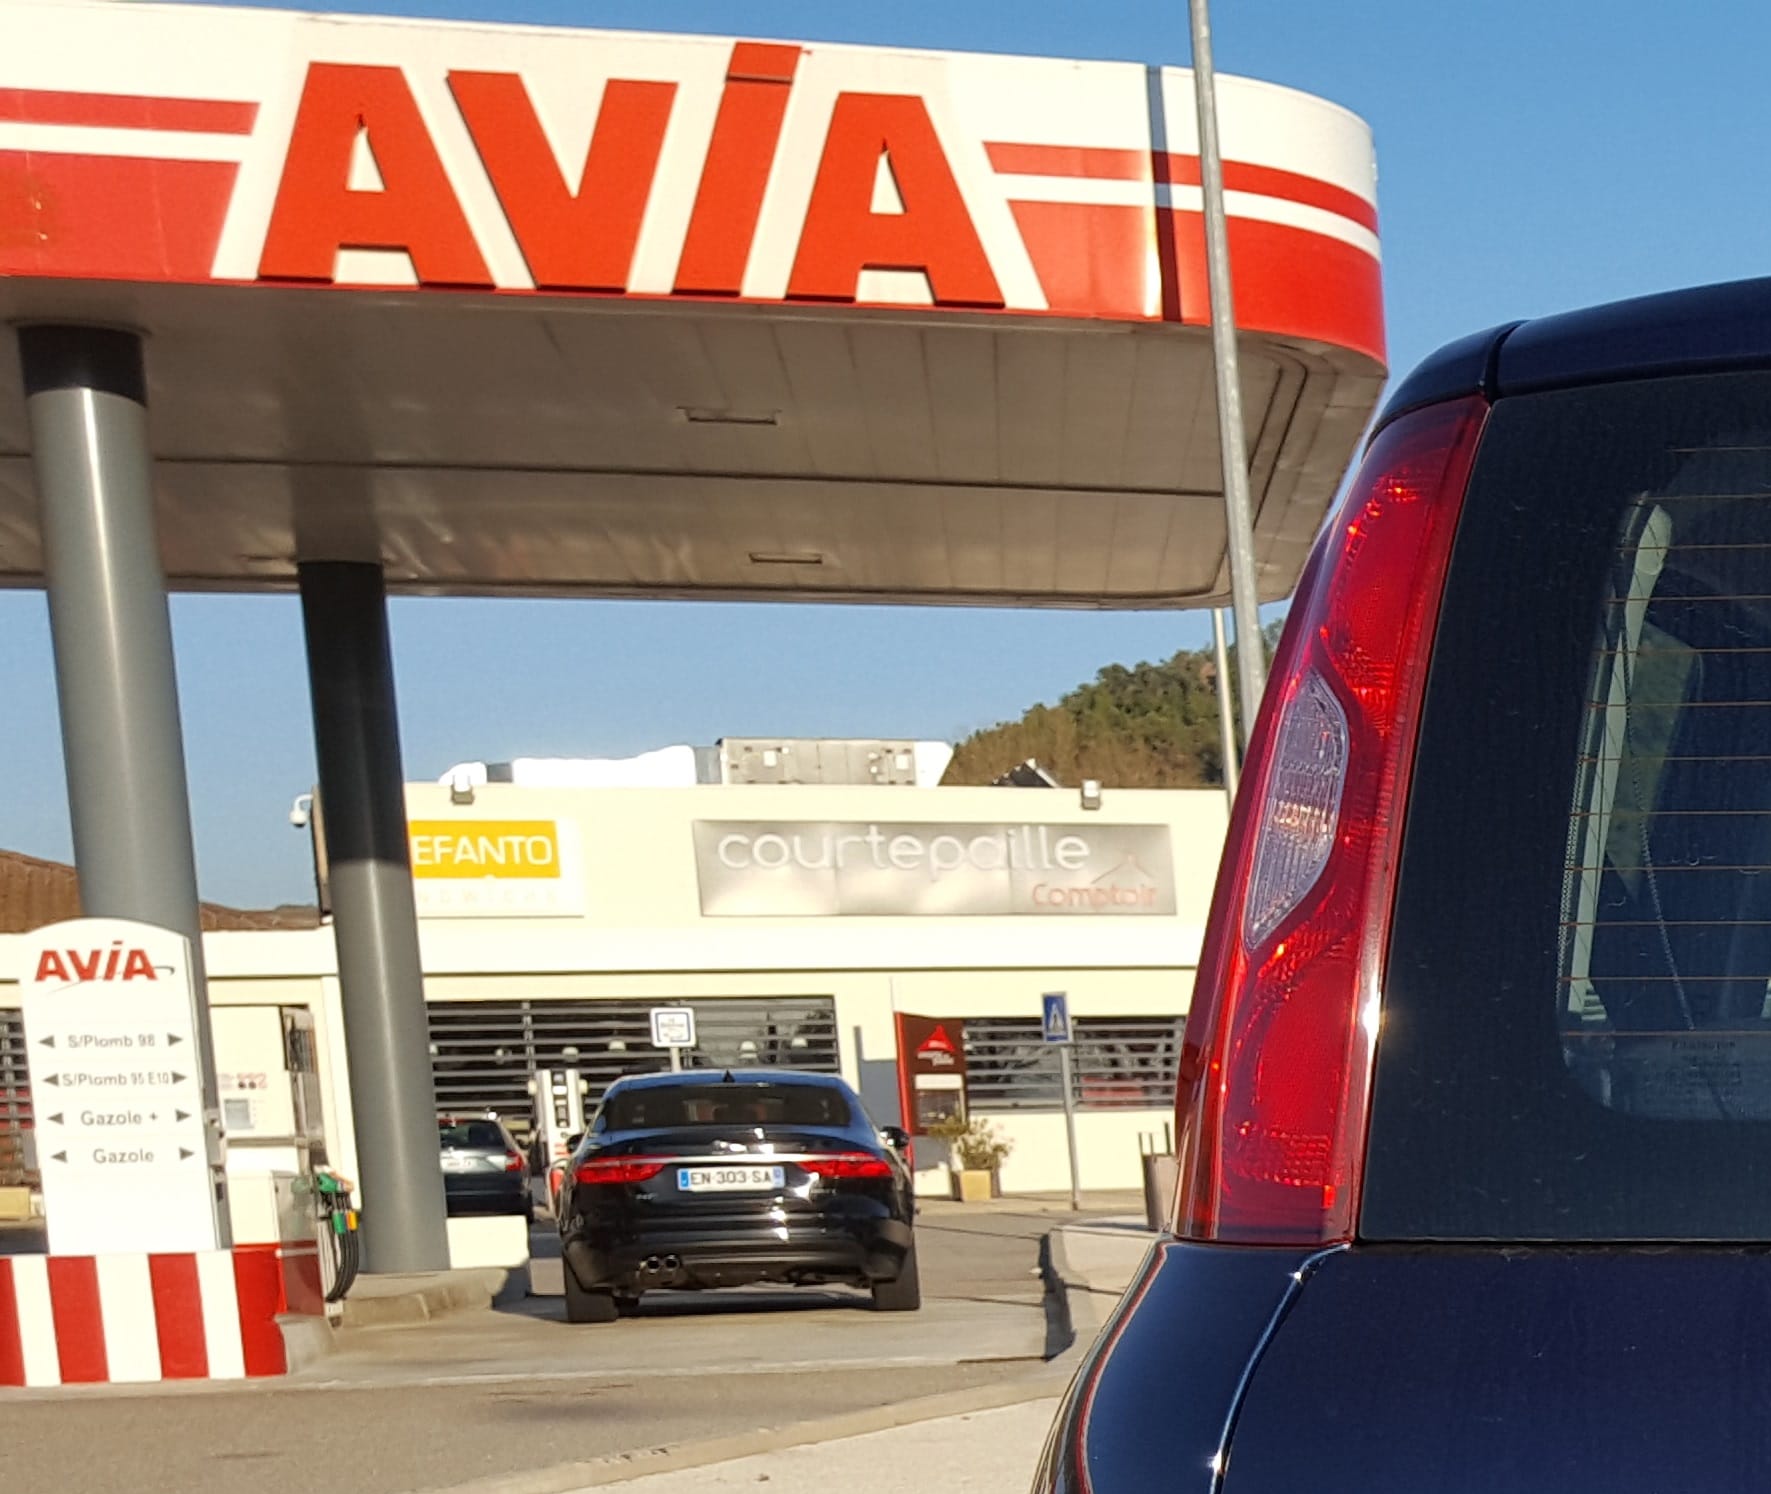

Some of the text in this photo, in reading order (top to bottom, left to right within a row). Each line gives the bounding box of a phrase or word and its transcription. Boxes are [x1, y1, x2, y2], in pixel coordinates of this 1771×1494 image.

[717, 825, 1091, 882] courtepaille
[80, 1110, 142, 1126] Gazole
[93, 1148, 154, 1164] Gazole
